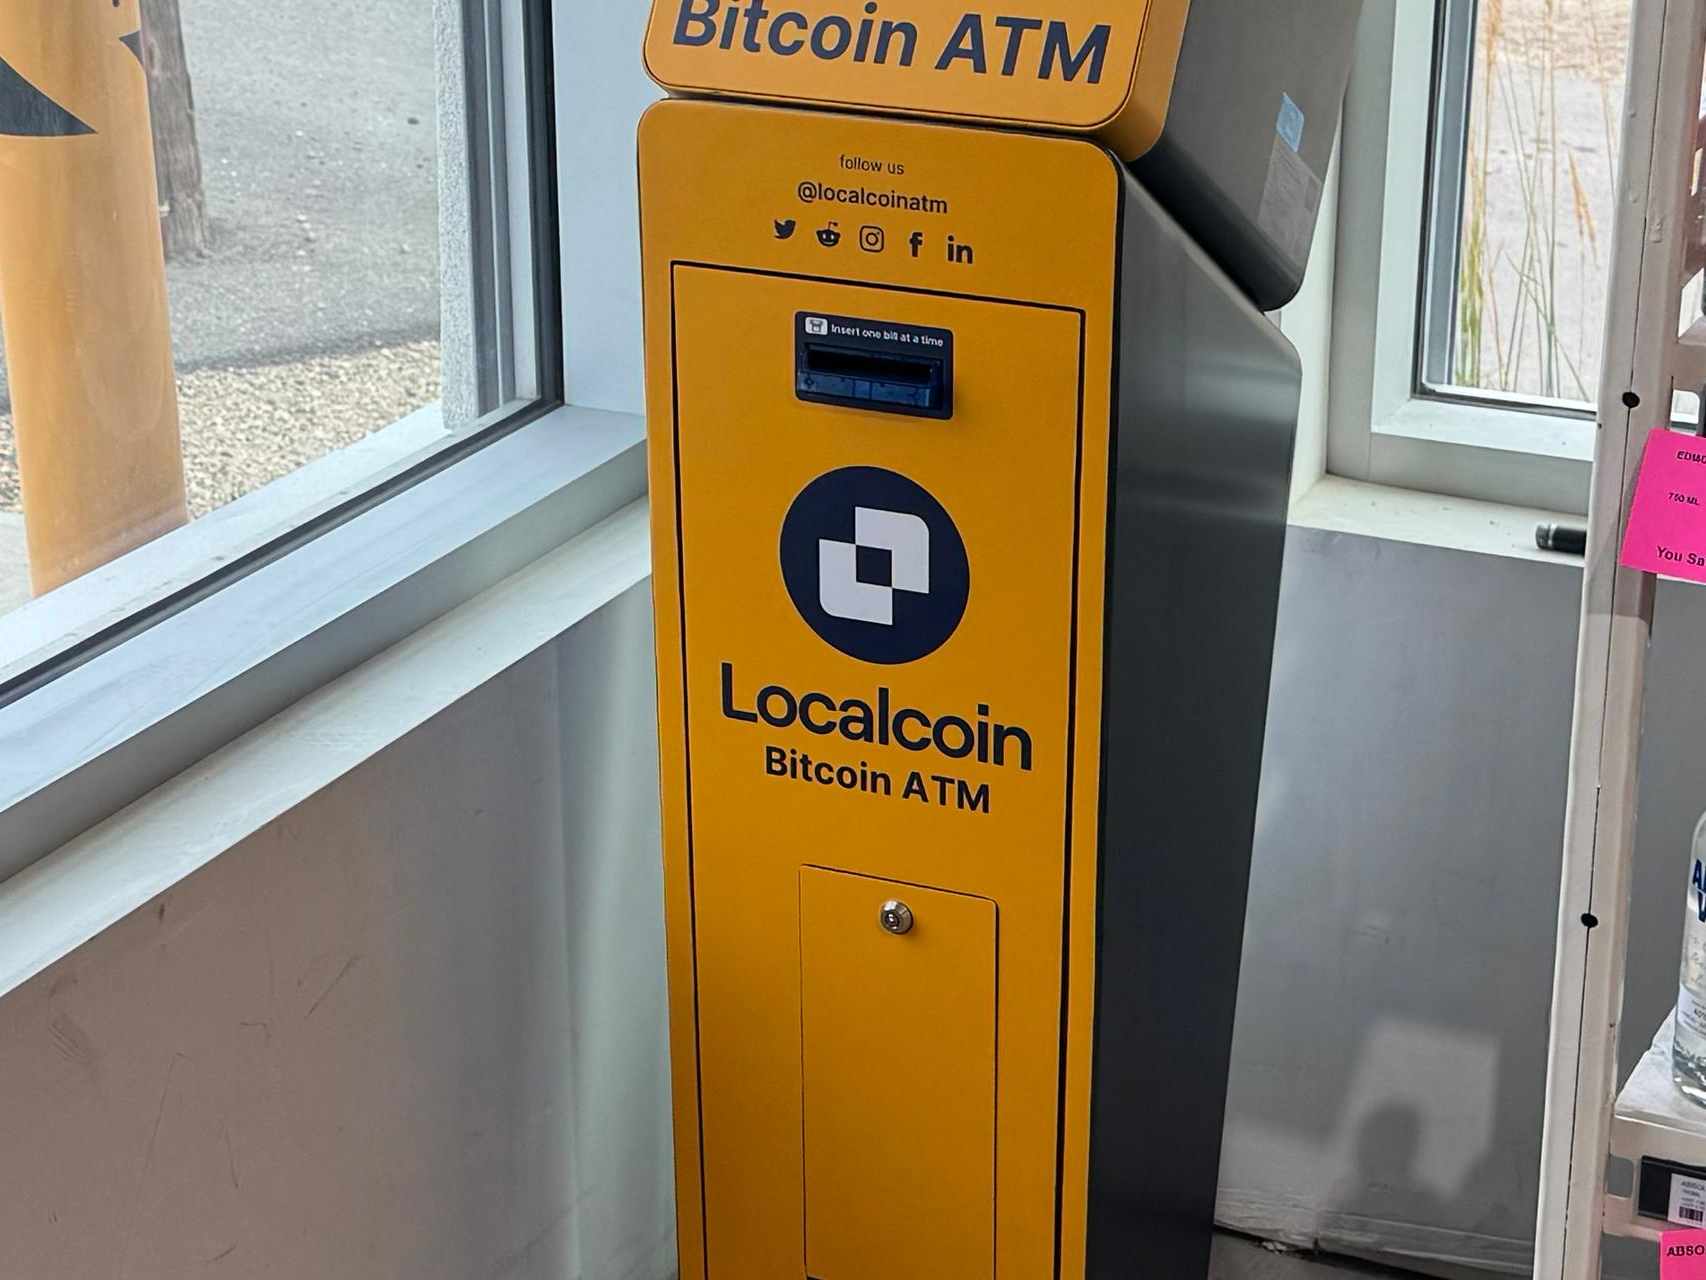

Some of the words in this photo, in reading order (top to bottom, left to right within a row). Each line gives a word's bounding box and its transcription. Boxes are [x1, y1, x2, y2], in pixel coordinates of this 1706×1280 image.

[935, 13, 1112, 84] ATM
[840, 154, 882, 172] follow
[887, 162, 905, 175] us
[798, 181, 948, 214] @localcoinatm
[831, 324, 860, 337] Insert
[862, 328, 881, 339] one
[883, 330, 898, 341] bill
[900, 332, 910, 342] at
[921, 336, 944, 347] time
[1657, 547, 1682, 561] You
[721, 662, 1032, 771] Localcoin
[766, 746, 891, 796] Bitcoin
[902, 771, 989, 813] ATM
